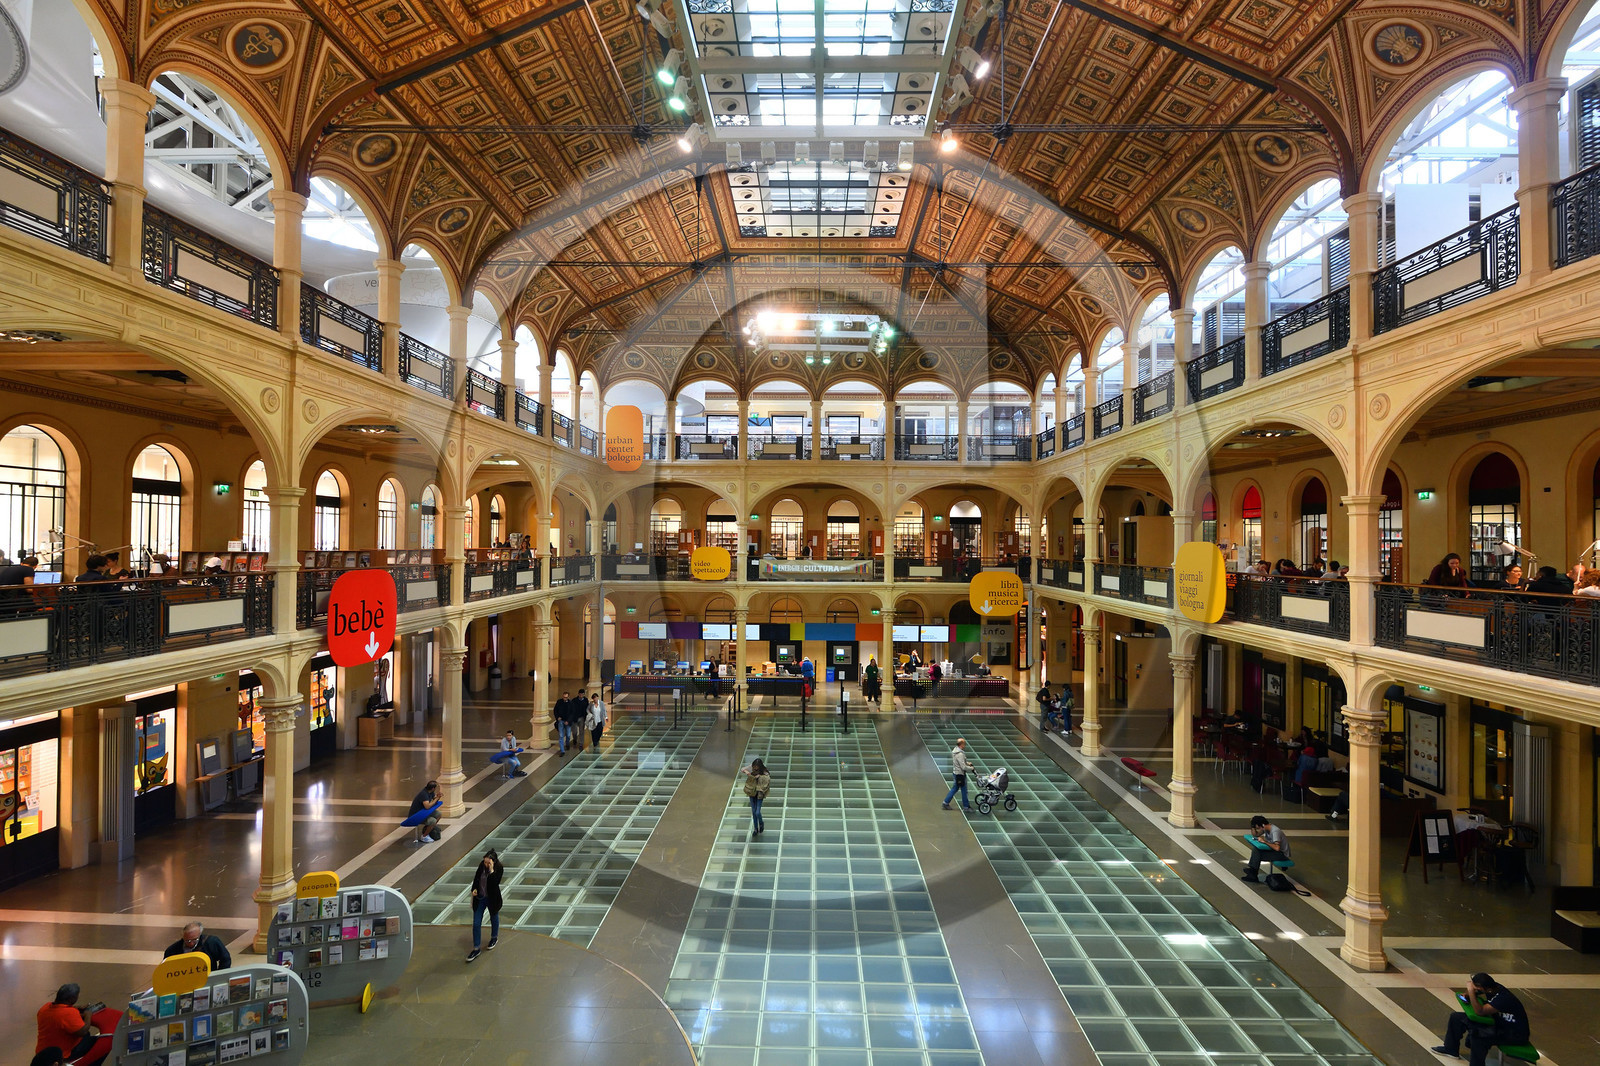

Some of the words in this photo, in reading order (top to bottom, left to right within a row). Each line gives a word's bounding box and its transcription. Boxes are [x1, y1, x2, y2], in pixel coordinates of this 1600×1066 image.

[607, 436, 633, 444] urban
[607, 453, 641, 463] bologna
[694, 567, 726, 575] spettacolo
[1179, 571, 1203, 583] giornali
[1001, 581, 1019, 589] libri
[1180, 584, 1198, 598] viaggi
[990, 598, 1019, 606] ricerca
[1180, 596, 1204, 611] bologna
[333, 600, 384, 636] bebè
[302, 883, 337, 892] proposte
